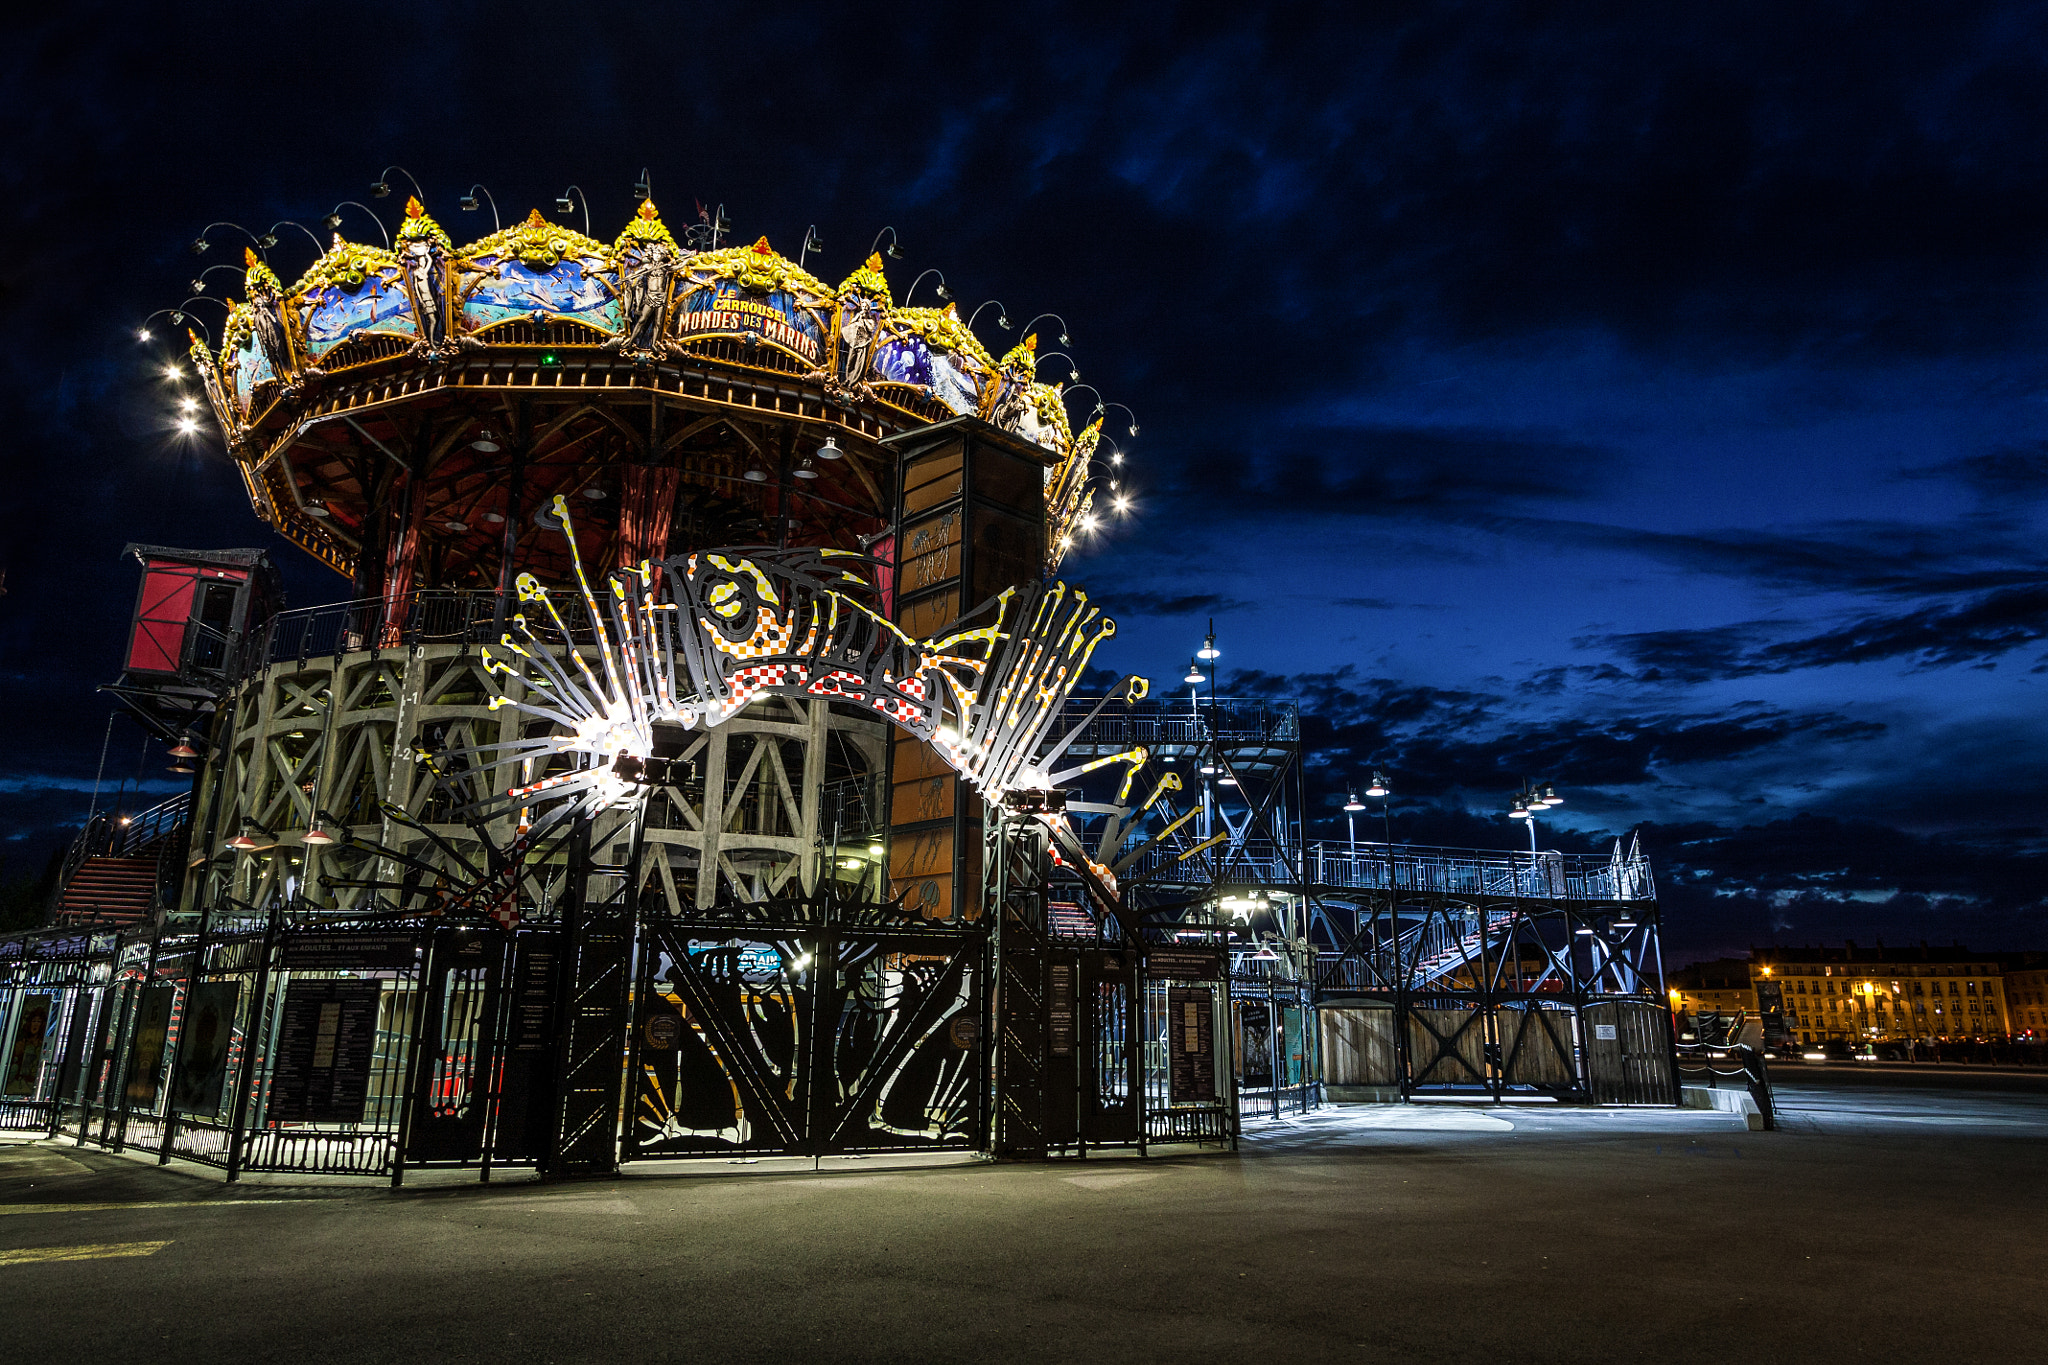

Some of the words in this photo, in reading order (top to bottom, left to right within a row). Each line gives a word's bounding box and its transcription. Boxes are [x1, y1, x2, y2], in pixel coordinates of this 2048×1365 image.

[717, 289, 736, 298] LE
[712, 299, 789, 326] CARROUSEL
[678, 311, 741, 335] MONDES
[743, 313, 762, 328] DES
[764, 319, 819, 360] MARINS
